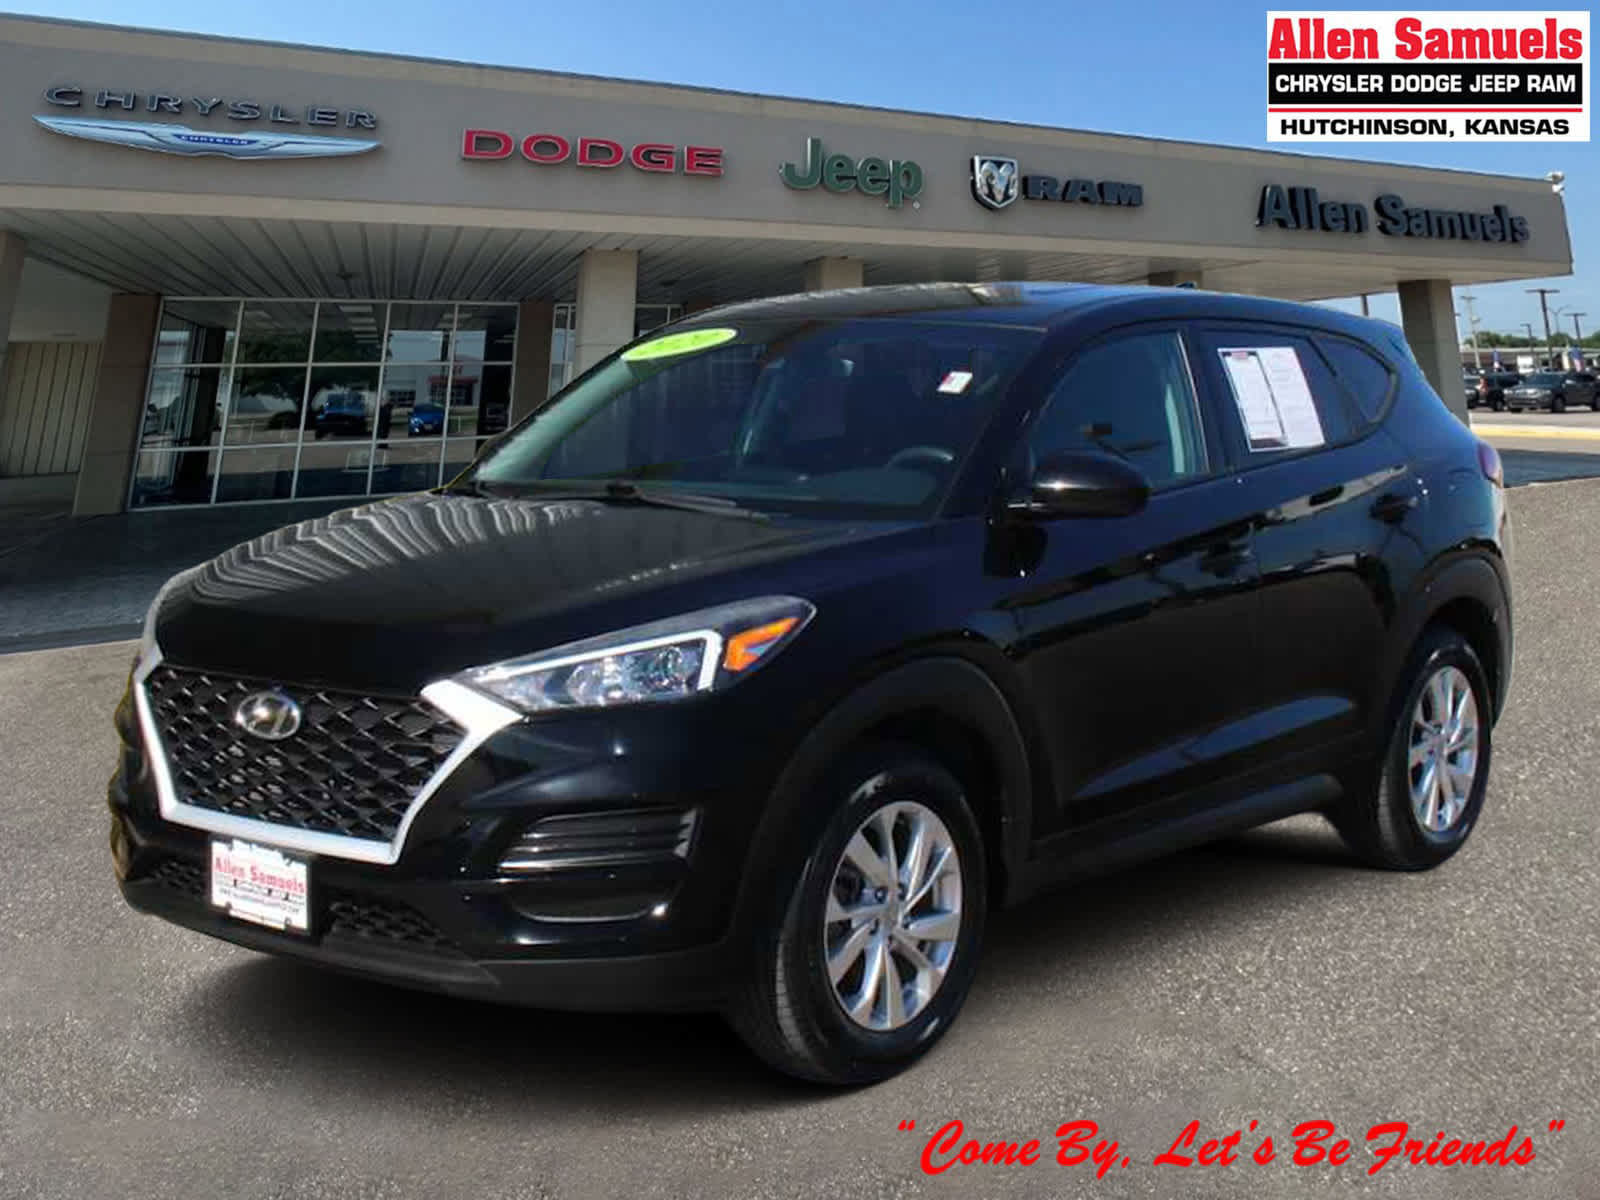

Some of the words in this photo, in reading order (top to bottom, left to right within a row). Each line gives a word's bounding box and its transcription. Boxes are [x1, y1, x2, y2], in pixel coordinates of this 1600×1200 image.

[43, 86, 378, 130] CHRYSLER
[461, 128, 725, 177] DODGE
[778, 136, 924, 210] Jeep
[1023, 174, 1144, 207] RAM
[1256, 184, 1368, 234] Allen
[1375, 194, 1531, 243] Samuels
[250, 864, 306, 894] Samuels
